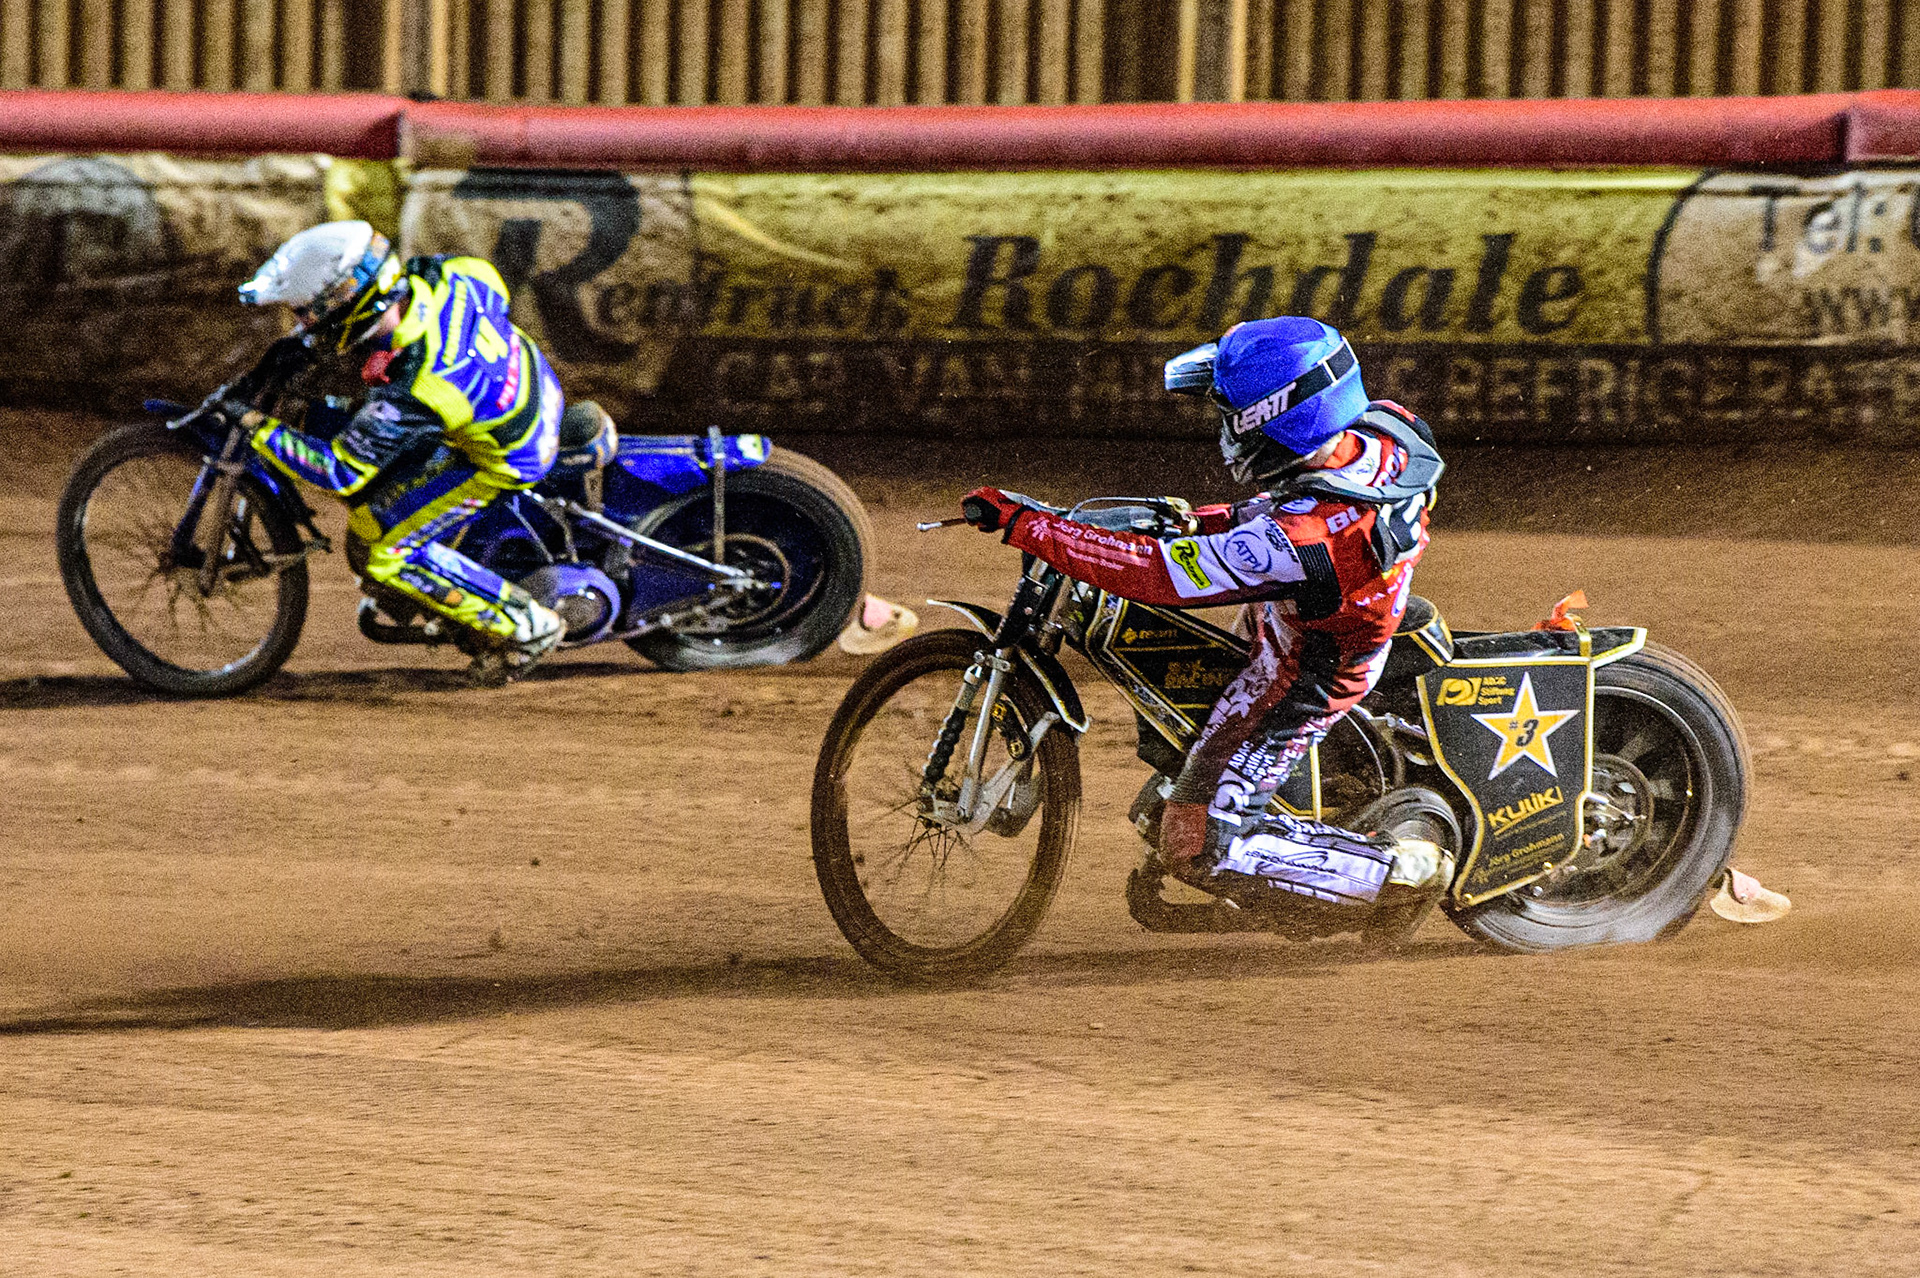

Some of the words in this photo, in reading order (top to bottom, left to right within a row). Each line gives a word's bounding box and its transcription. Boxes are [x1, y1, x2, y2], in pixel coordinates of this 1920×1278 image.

[946, 231, 1586, 335] Rochdale
[1233, 382, 1297, 434] LEATT
[1508, 719, 1539, 747] #3
[1228, 740, 1255, 769] ADAC
